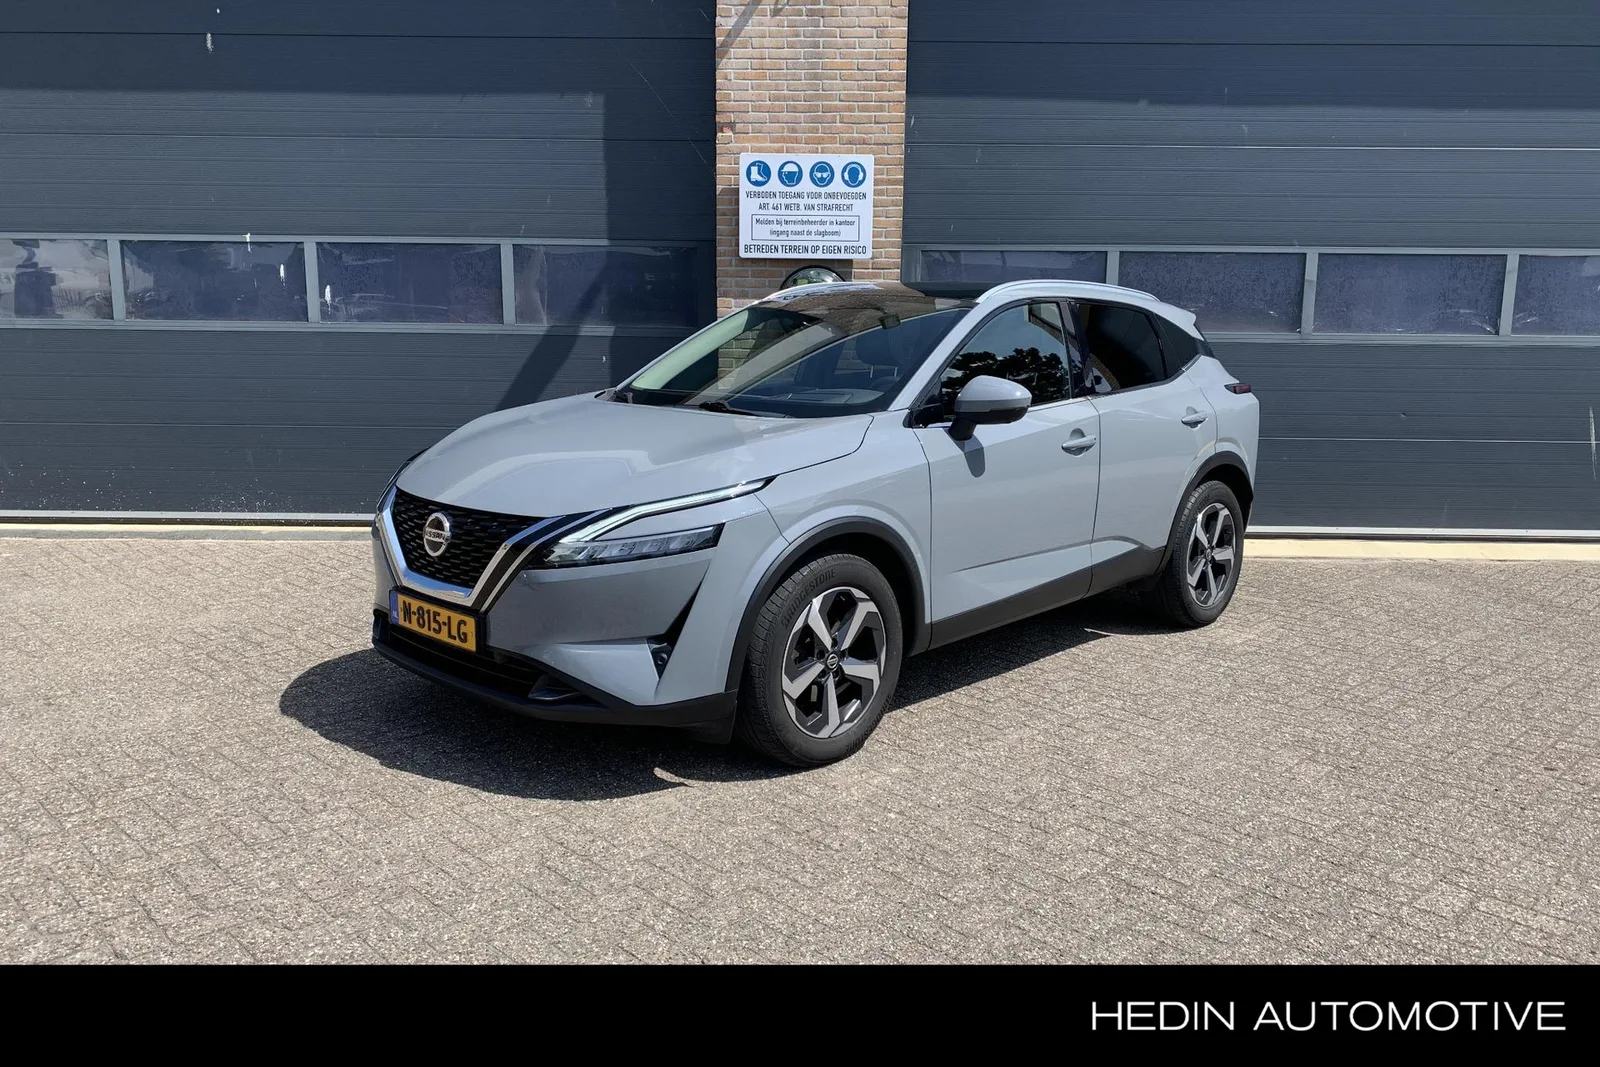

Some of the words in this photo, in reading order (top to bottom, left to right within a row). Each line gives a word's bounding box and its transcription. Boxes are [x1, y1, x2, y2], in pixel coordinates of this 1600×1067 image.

[745, 190, 777, 199] VERBODEN
[778, 191, 805, 200] TOEGANG
[806, 191, 823, 200] VOOR
[824, 191, 867, 200] ONBEVOEGDEN
[783, 203, 802, 211] WETB.
[803, 203, 816, 211] VAN
[816, 203, 854, 212] STRAFRECHT
[755, 218, 775, 226] Melden
[783, 218, 828, 227] terreinbeheerder
[835, 219, 855, 227] kantoor
[769, 228, 789, 238] (ingang
[813, 229, 842, 238] slagboom)
[744, 244, 779, 254] BETREDEN
[780, 244, 809, 254] TERREIN
[810, 245, 820, 254] OP
[821, 245, 842, 254] EIGEN
[843, 245, 867, 255] RISICO
[402, 599, 468, 644] N-815-LG
